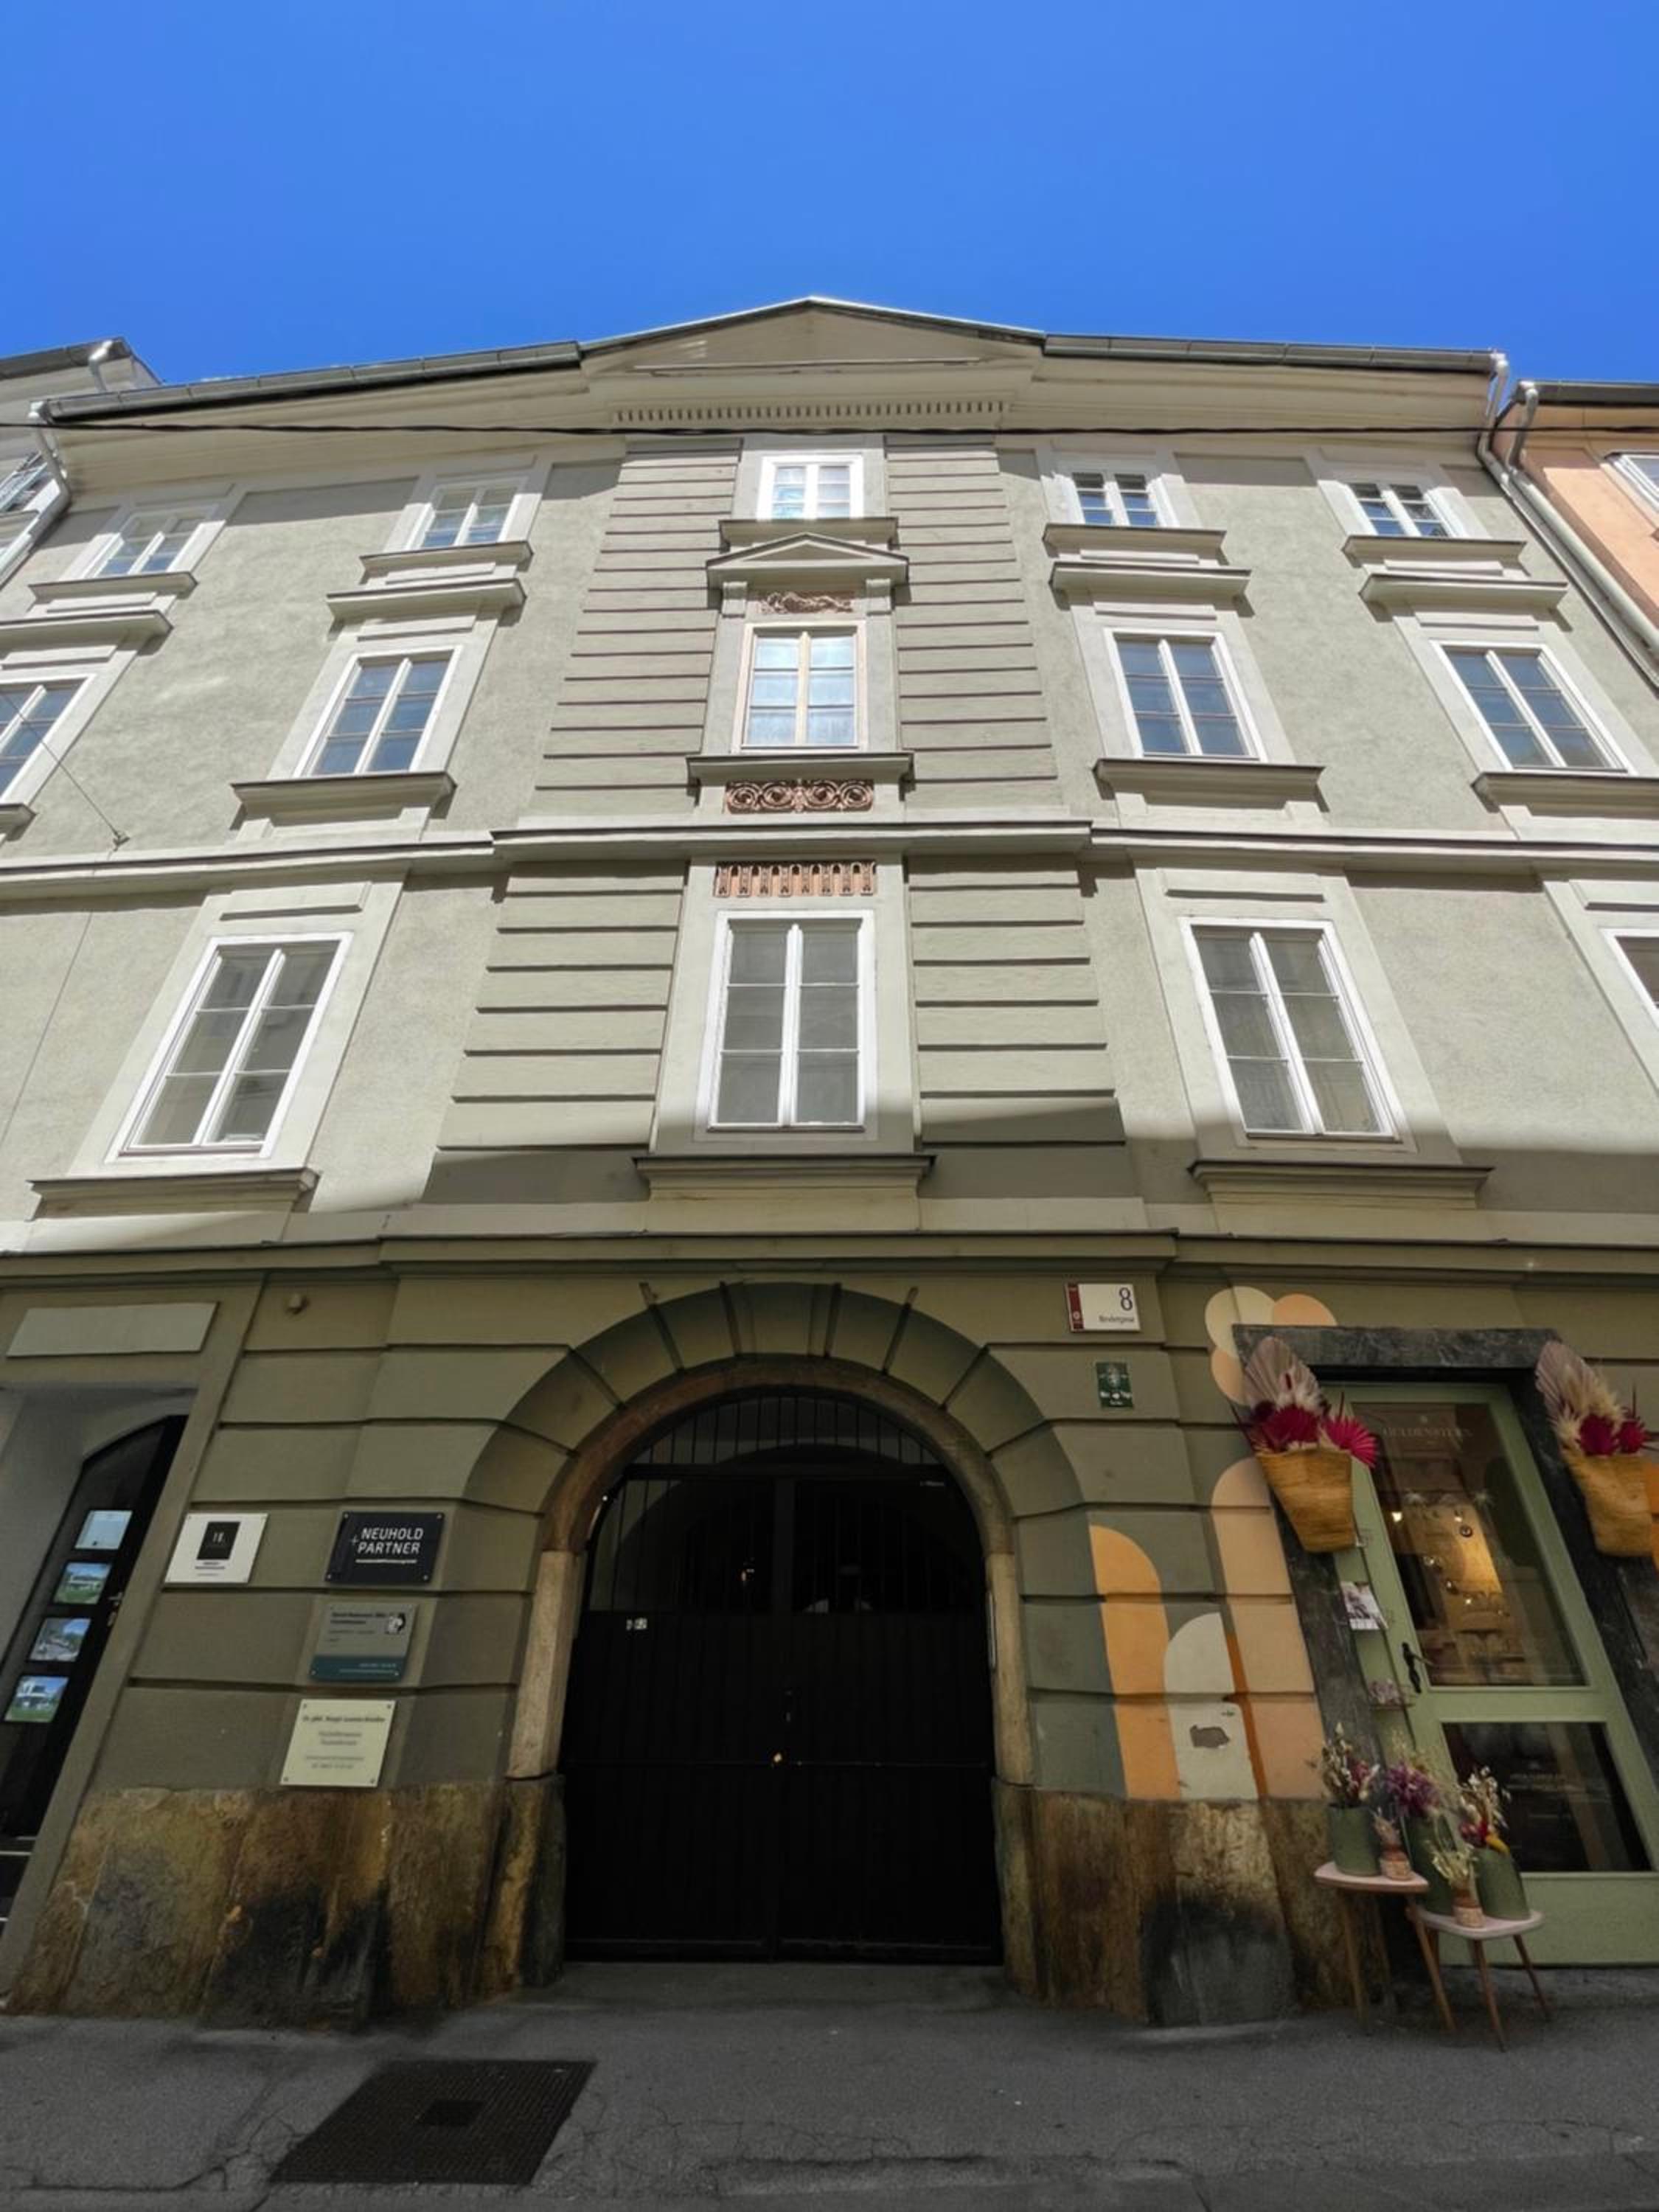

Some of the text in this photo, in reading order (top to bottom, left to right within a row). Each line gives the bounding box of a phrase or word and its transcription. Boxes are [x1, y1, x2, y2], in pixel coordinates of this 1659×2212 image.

[1119, 1287, 1133, 1311] 8
[361, 1527, 424, 1540] NEUHOLD
[357, 1541, 421, 1554] PARTNER
